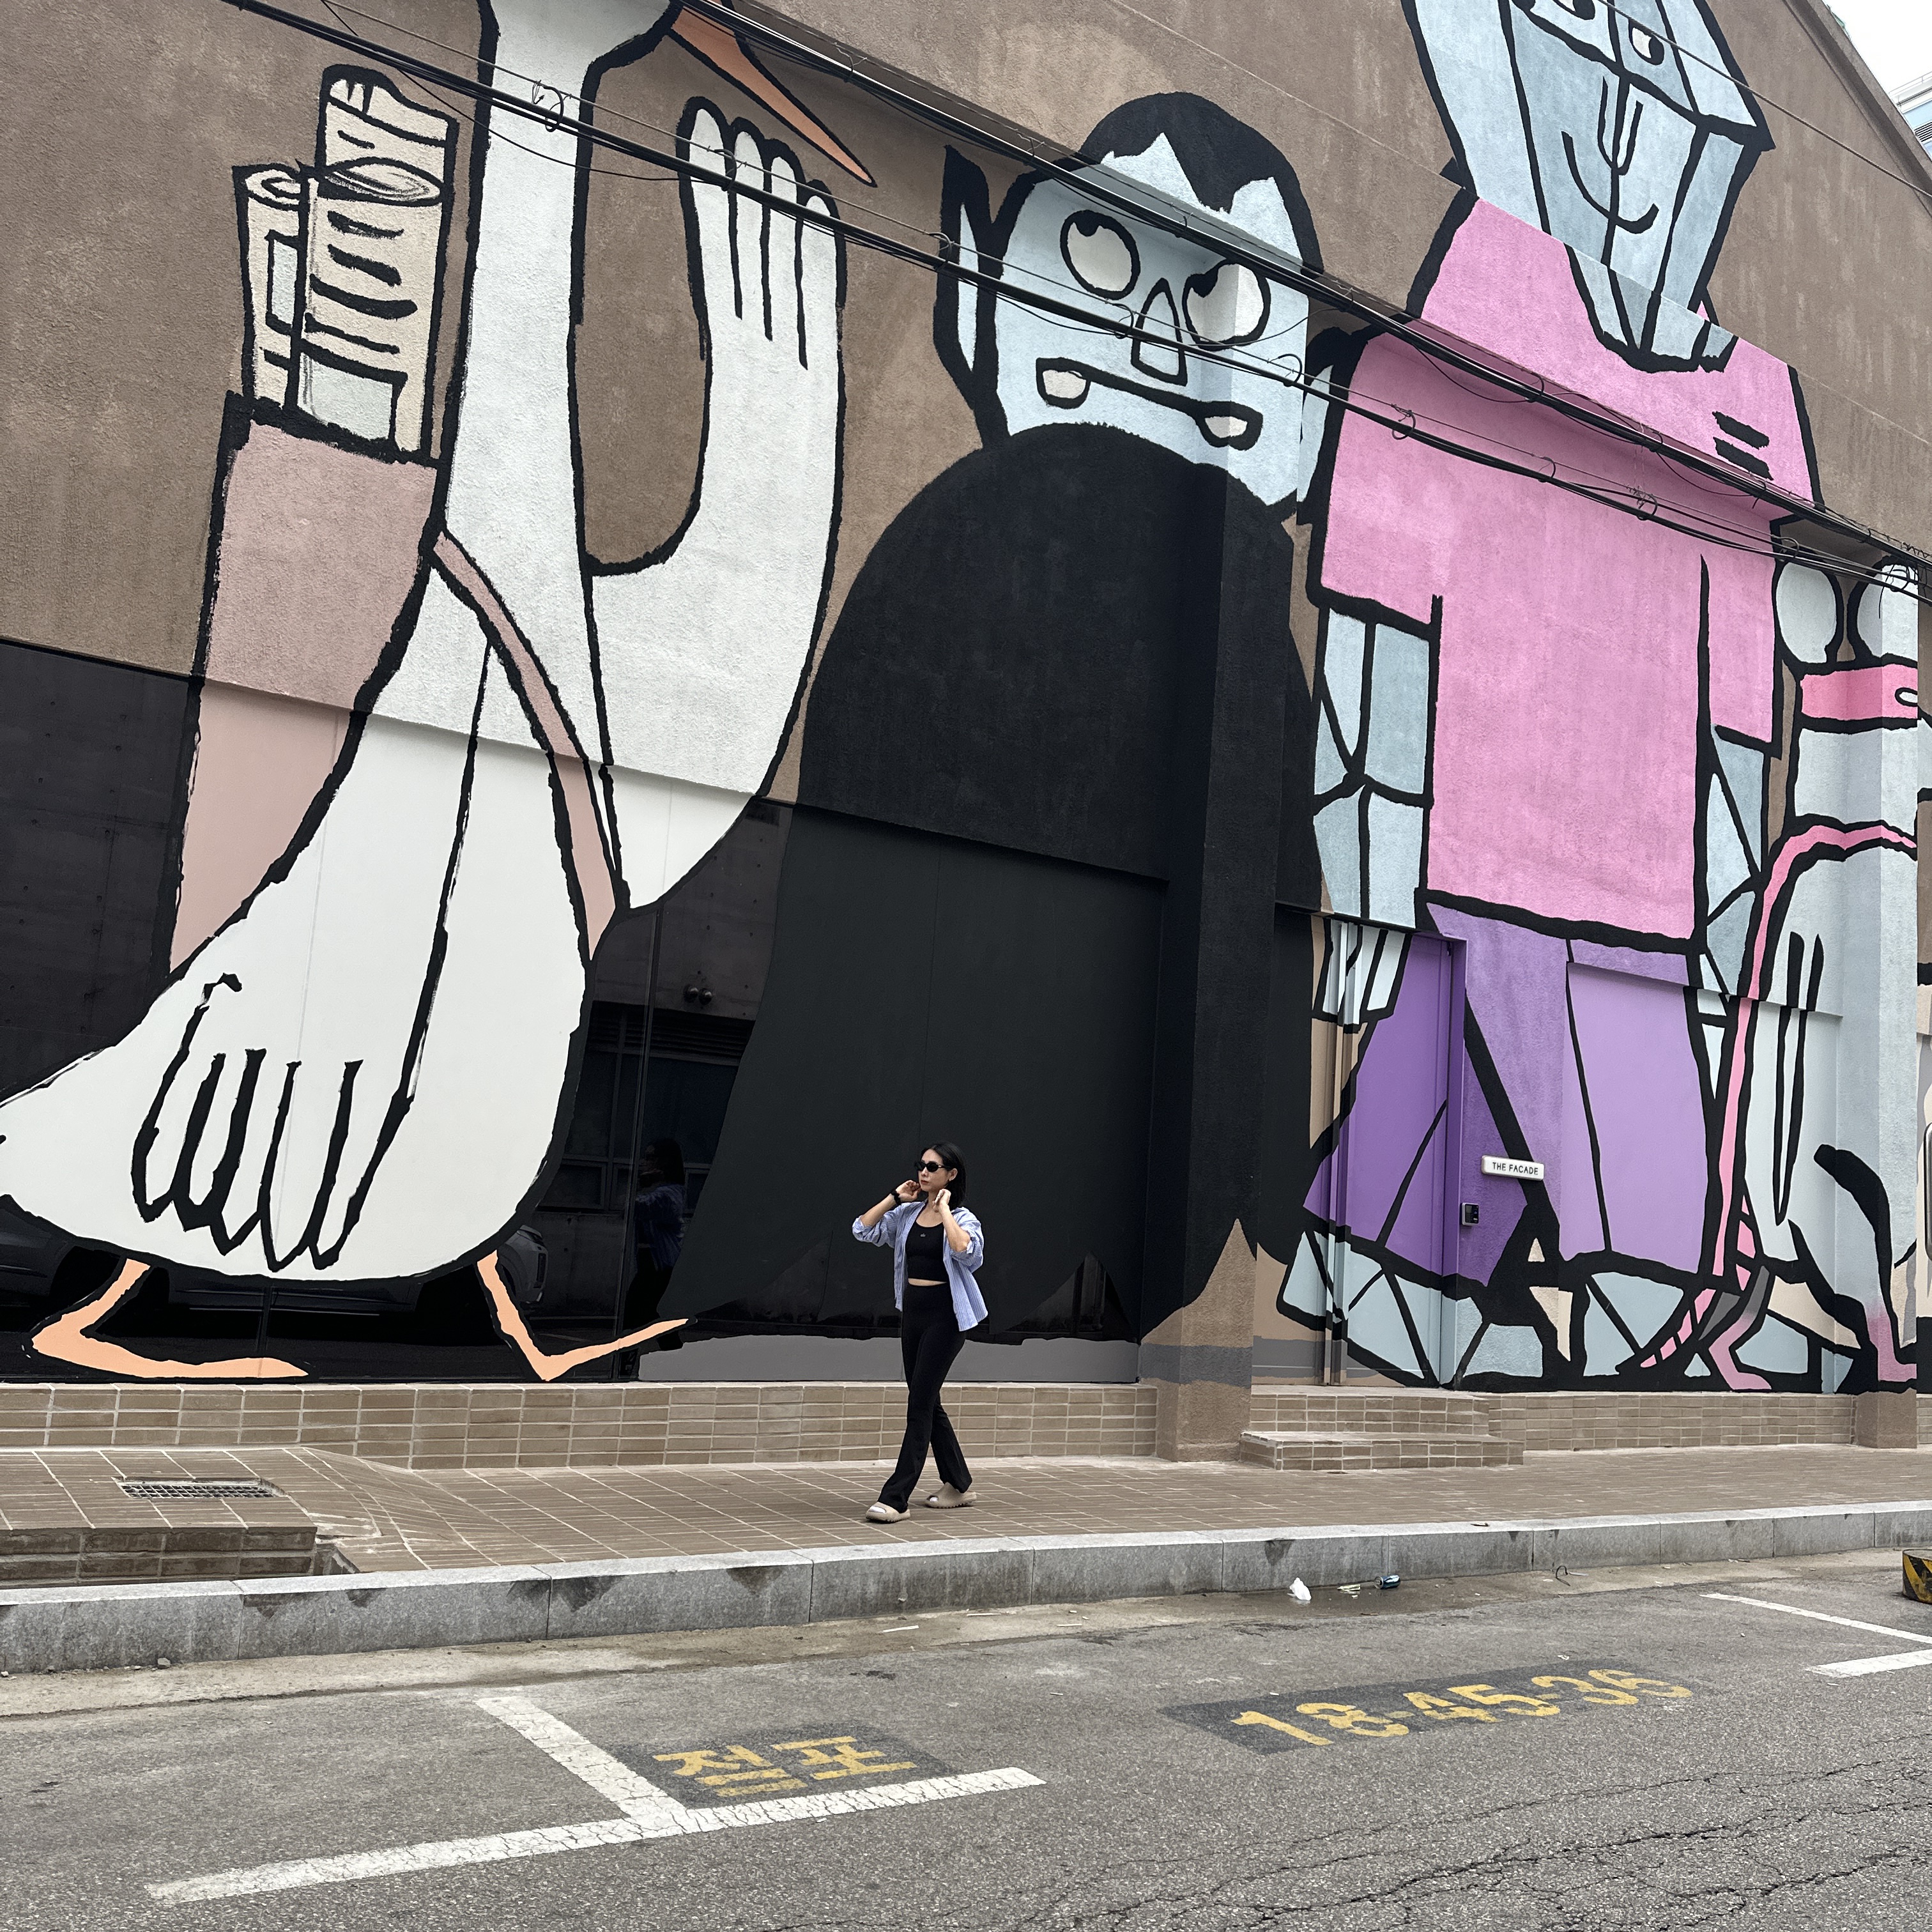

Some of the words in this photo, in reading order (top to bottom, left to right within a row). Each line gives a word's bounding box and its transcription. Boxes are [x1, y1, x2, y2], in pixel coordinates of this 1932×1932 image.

[1492, 1162, 1506, 1171] THE
[1509, 1164, 1538, 1176] FACADE
[1231, 1668, 1693, 1746] 18-45-36
